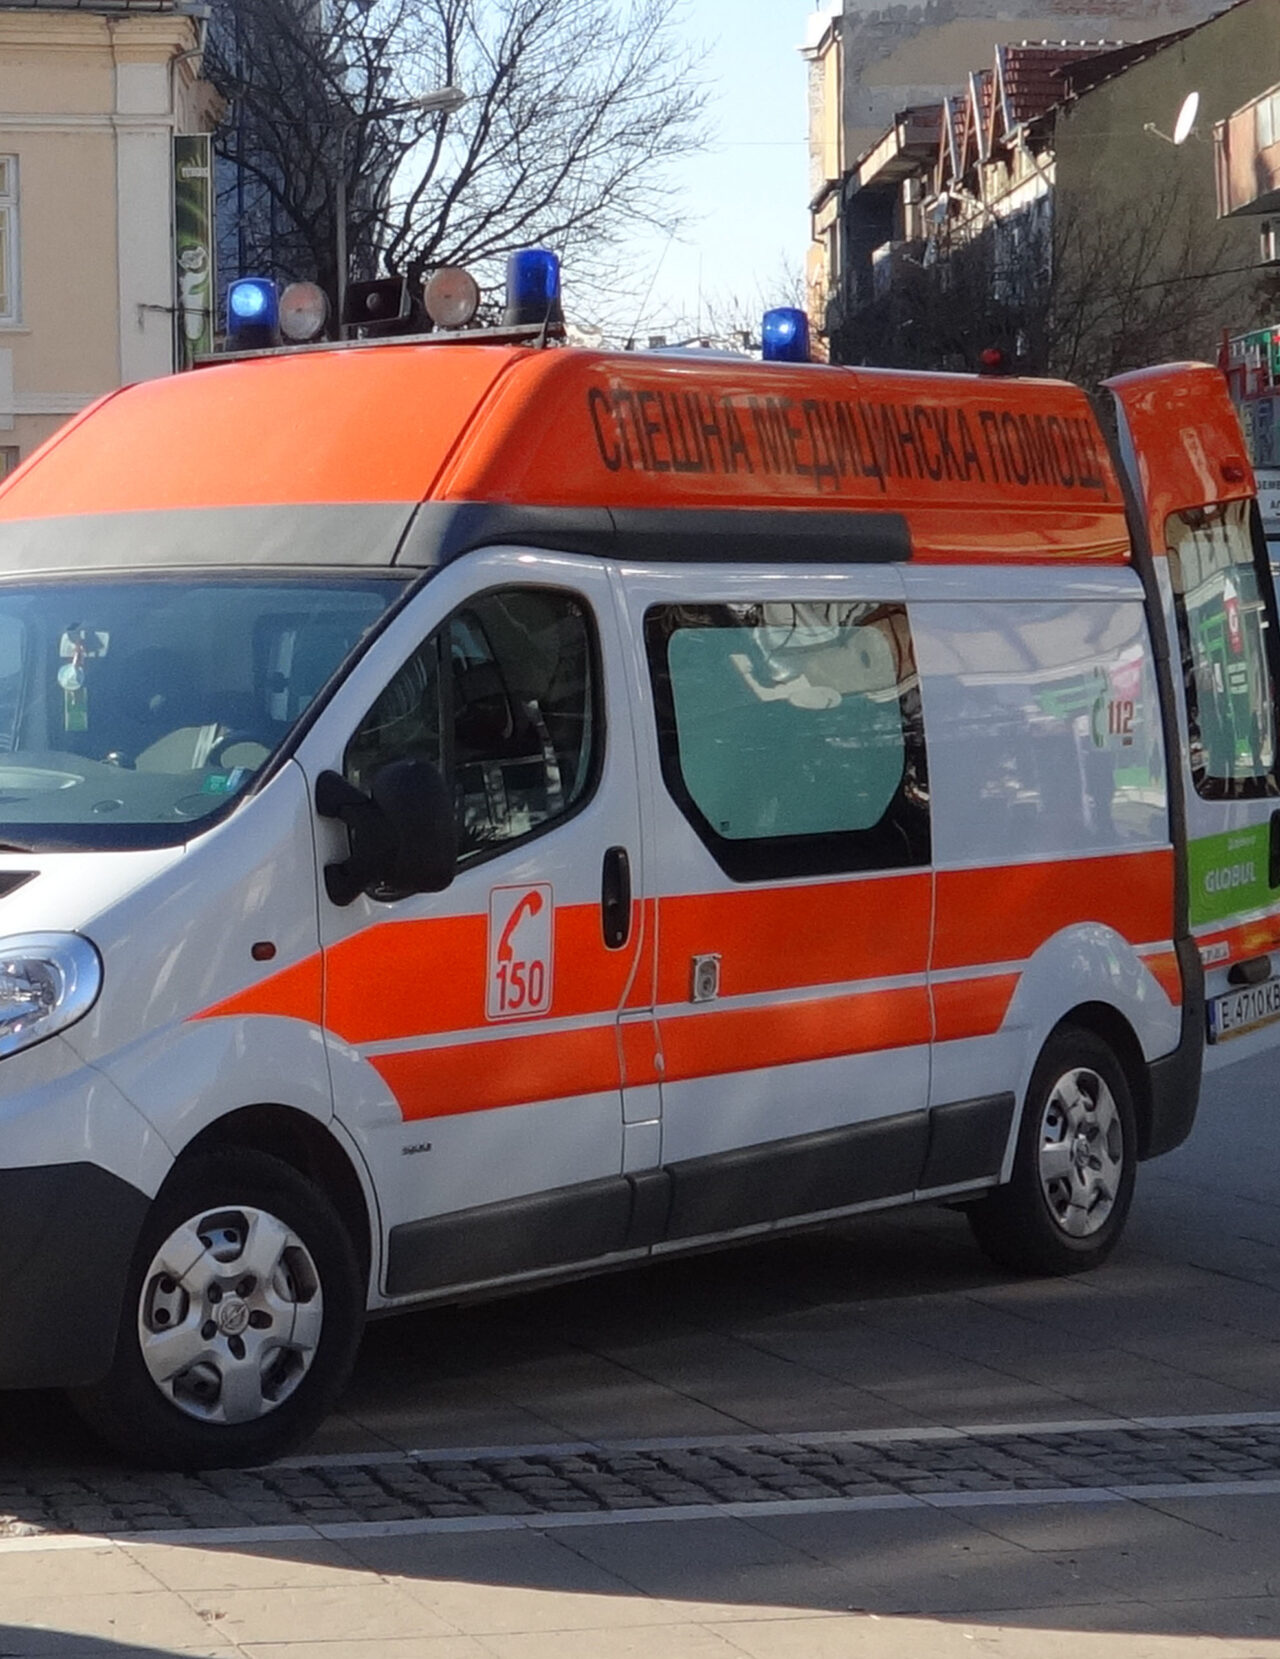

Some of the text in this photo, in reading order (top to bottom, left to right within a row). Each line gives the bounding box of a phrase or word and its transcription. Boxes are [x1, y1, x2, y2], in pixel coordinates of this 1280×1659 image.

[587, 387, 1110, 503] СПЕШНА МЕДИЦИНСКА ПОМОЩ
[1107, 700, 1134, 735] 112
[1204, 862, 1257, 894] GLOBUL
[496, 960, 545, 1012] 150
